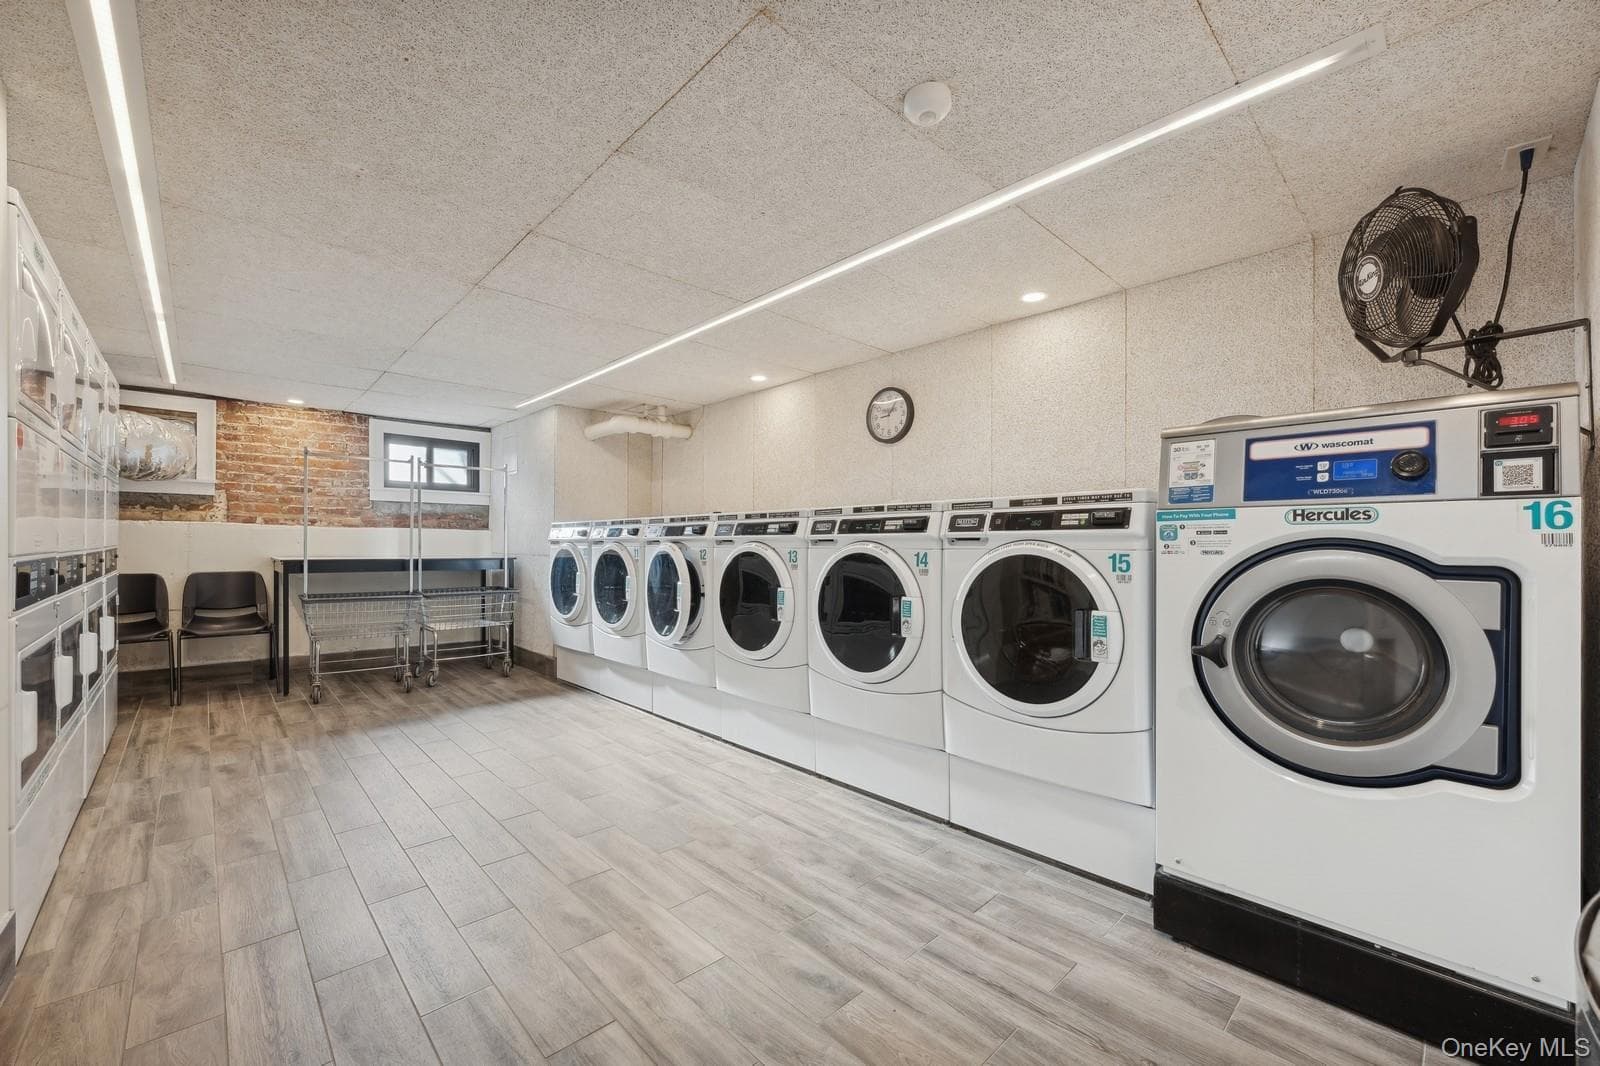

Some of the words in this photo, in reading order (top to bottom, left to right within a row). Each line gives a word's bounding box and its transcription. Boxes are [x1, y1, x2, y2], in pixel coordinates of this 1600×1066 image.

[1321, 438, 1374, 449] wascomat
[1292, 507, 1372, 522] Hercules
[1523, 500, 1574, 530] 16
[699, 549, 707, 560] 12
[788, 550, 798, 563] 13
[914, 552, 929, 567] 14
[1107, 553, 1131, 573] 15
